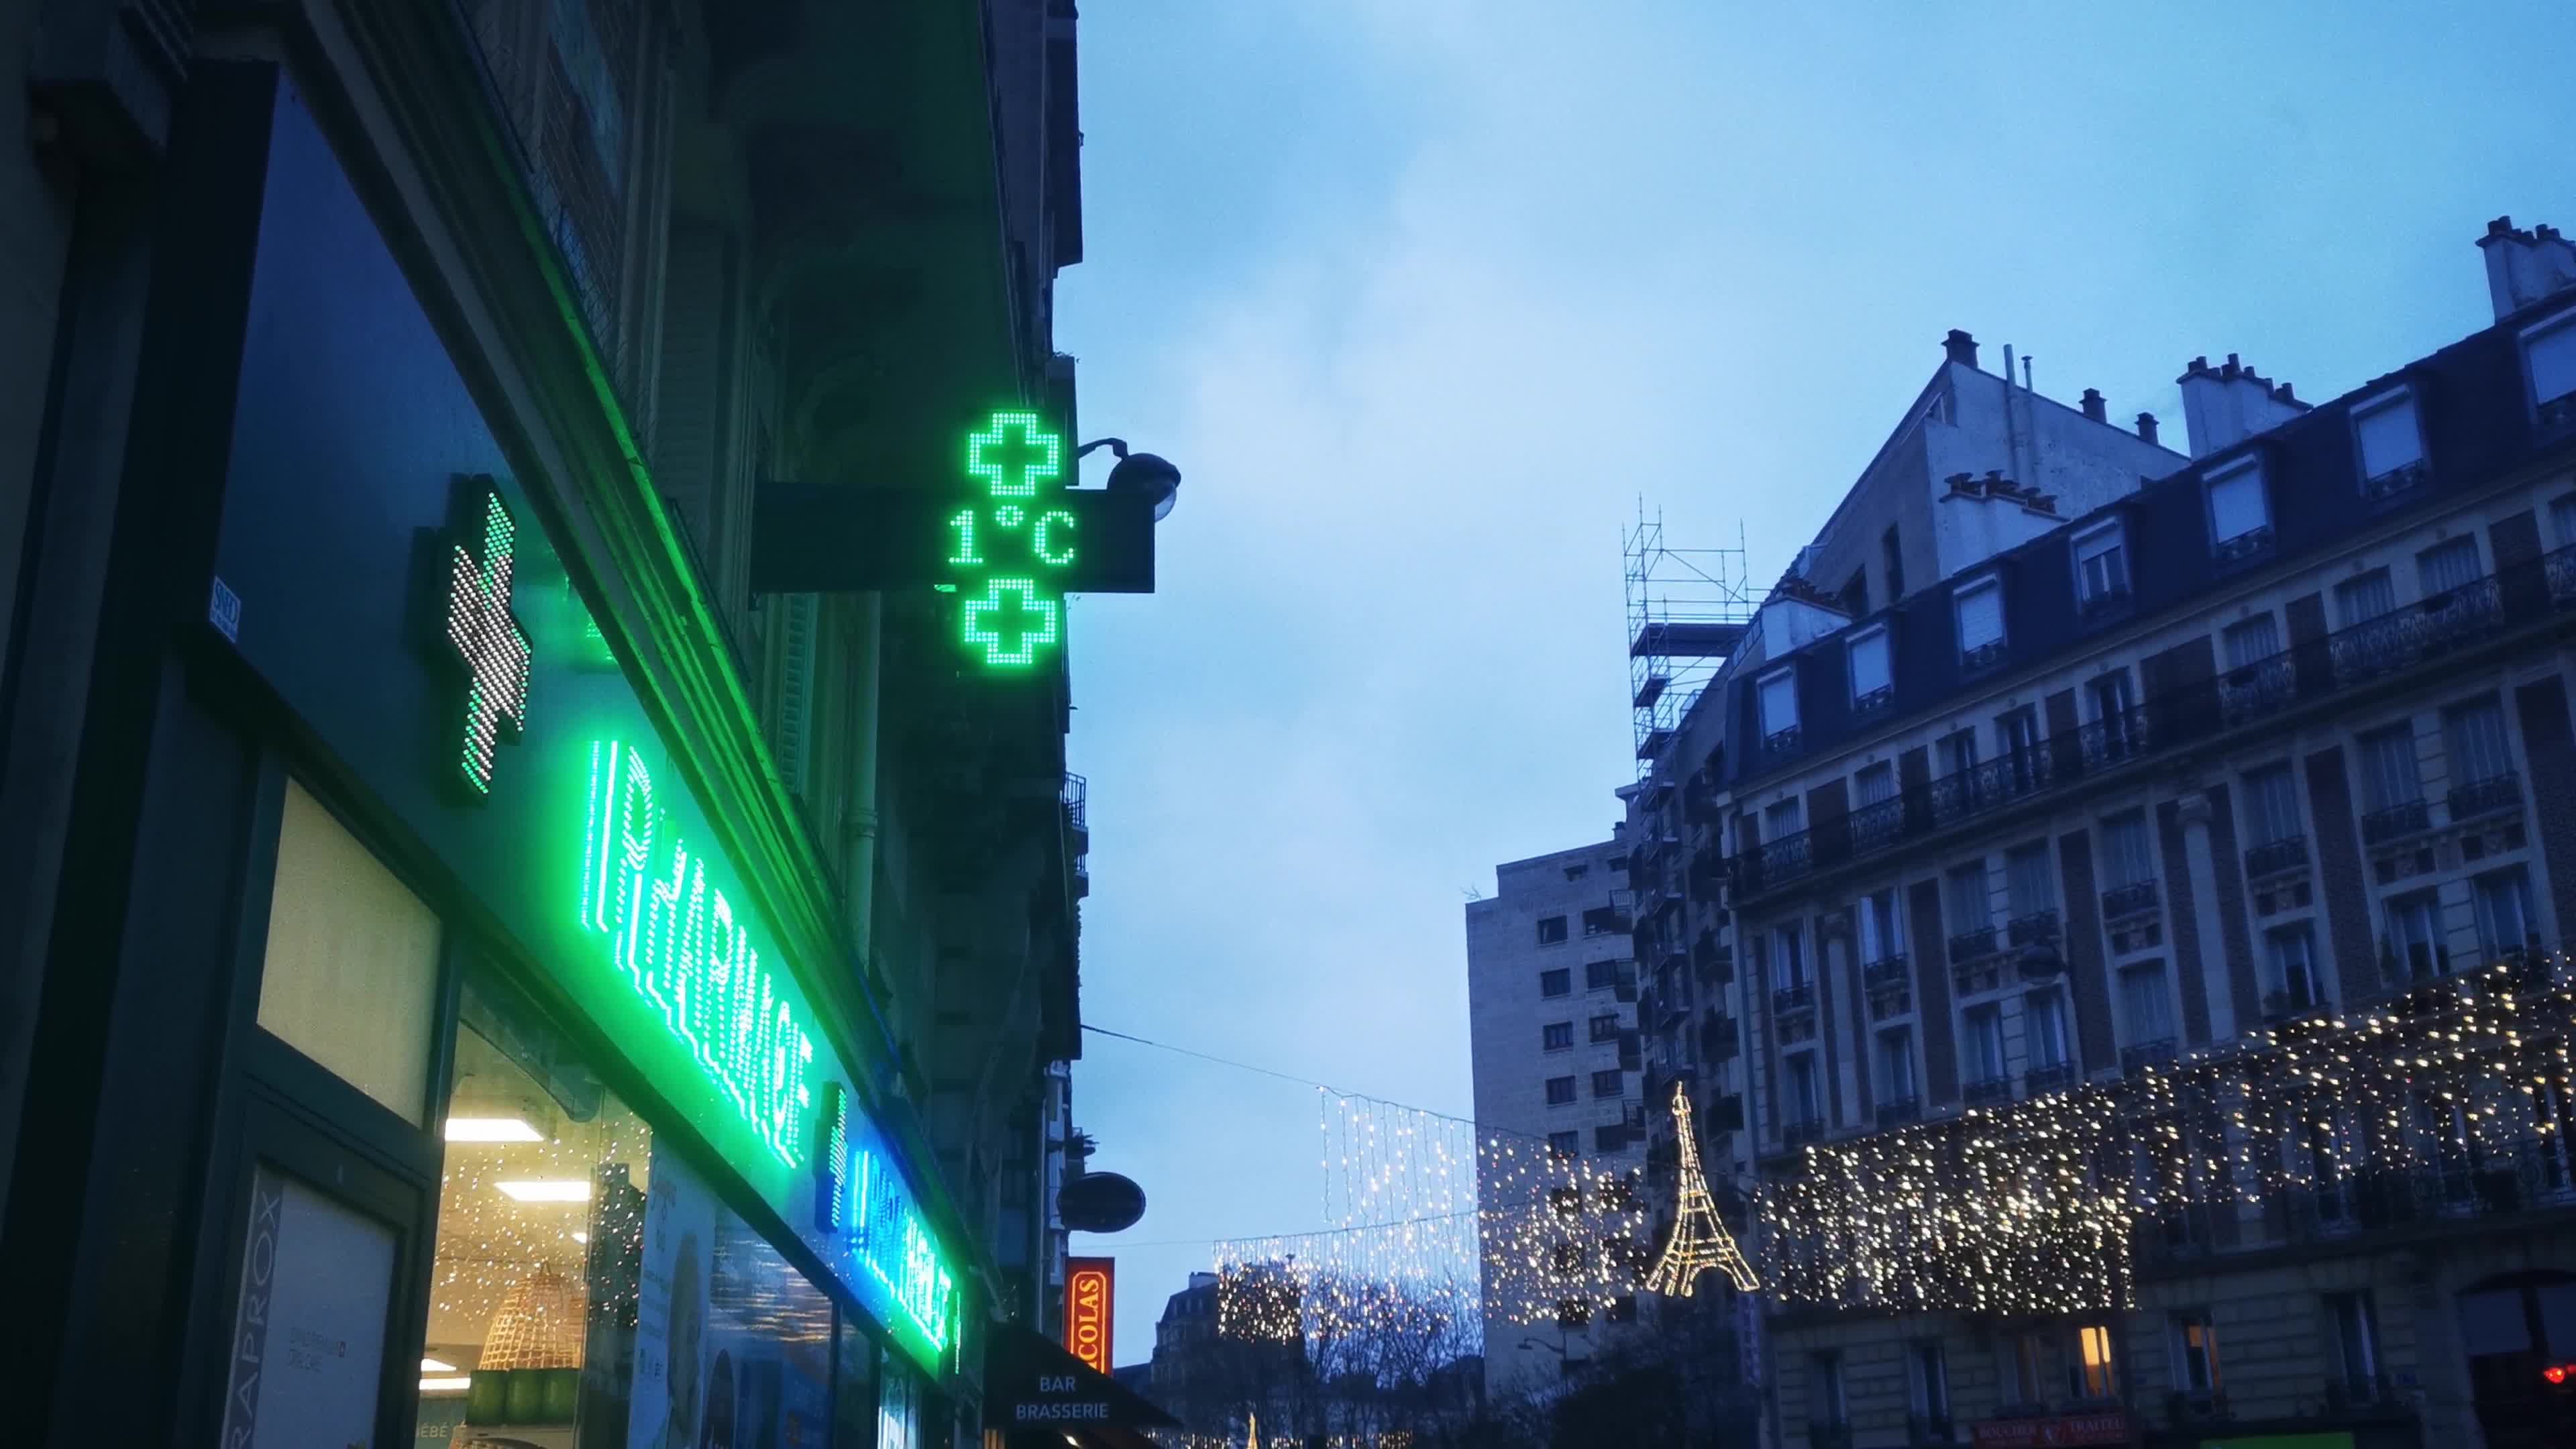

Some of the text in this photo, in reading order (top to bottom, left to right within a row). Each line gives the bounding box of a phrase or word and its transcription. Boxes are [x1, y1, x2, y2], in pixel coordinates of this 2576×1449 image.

[1040, 1377, 1076, 1393] BAR
[1016, 1403, 1110, 1420] BRASSERIE
[416, 1422, 449, 1438] ÉBÉ
